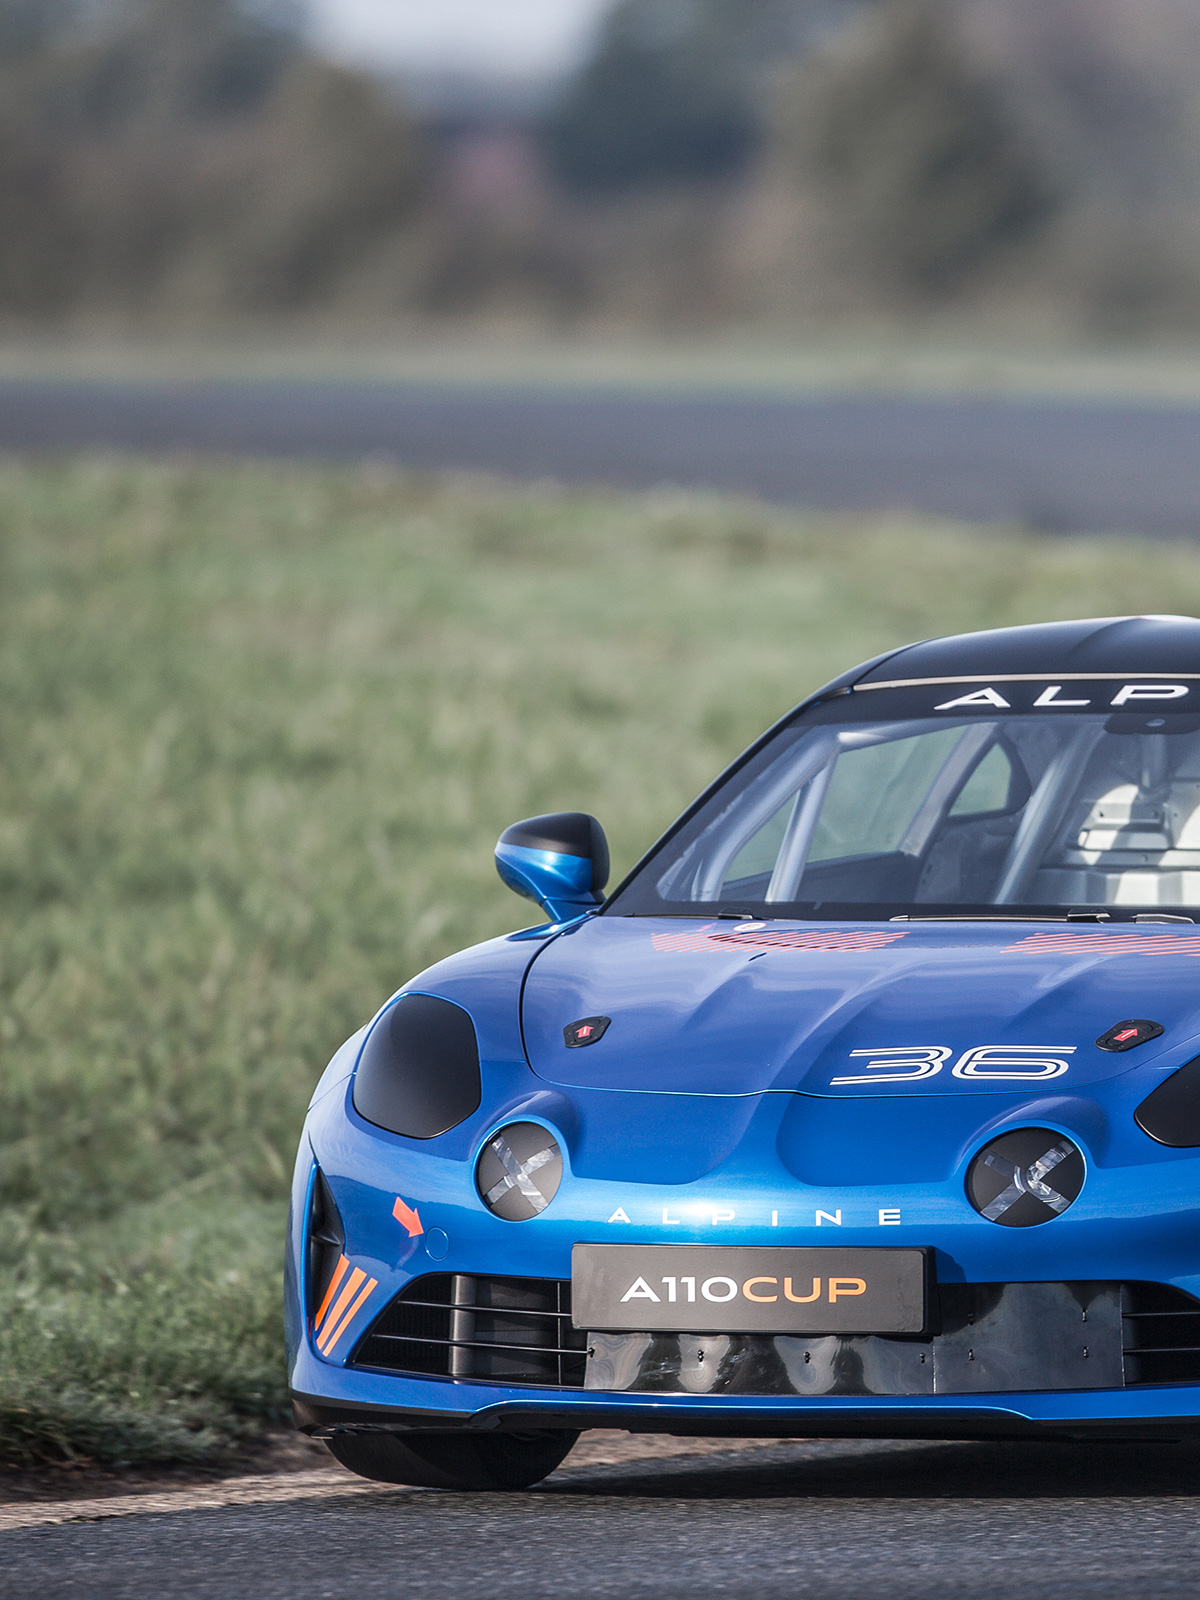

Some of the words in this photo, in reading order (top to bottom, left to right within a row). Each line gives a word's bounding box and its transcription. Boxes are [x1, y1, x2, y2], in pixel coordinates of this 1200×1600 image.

[830, 1045, 1077, 1084] 36
[609, 1208, 901, 1226] ALPINE
[620, 1277, 867, 1304] A110CUP
